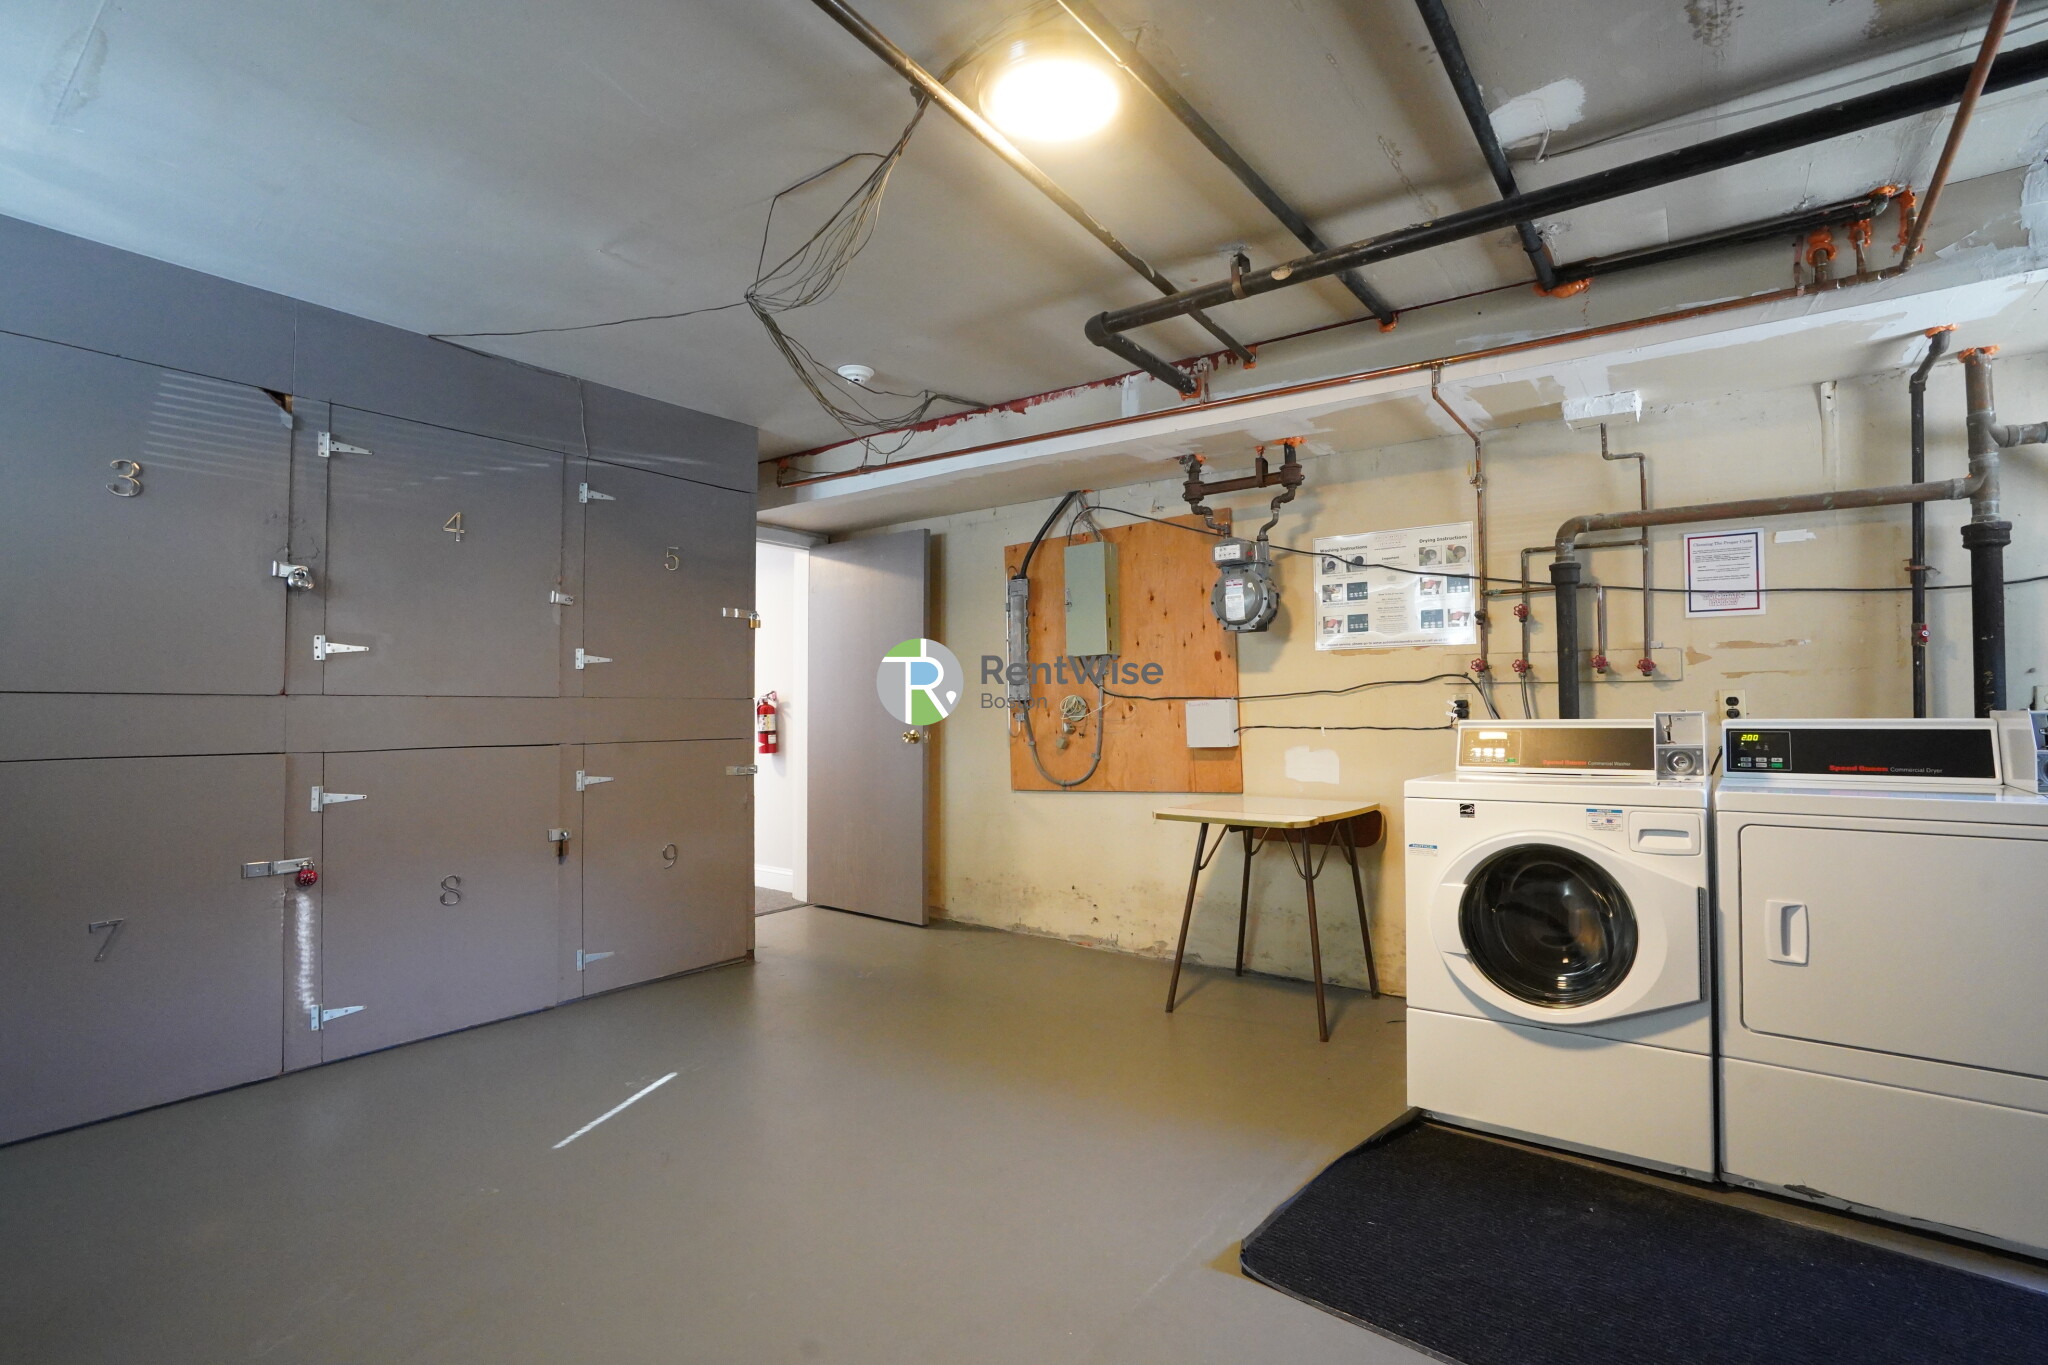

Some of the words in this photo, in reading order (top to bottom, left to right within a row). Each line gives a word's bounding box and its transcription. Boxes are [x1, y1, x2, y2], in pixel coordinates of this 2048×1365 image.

[106, 459, 144, 498] 3
[442, 510, 466, 542] 4
[1436, 534, 1468, 542] Instructions
[664, 545, 680, 572] 5
[1340, 544, 1368, 552] Instructions
[662, 842, 678, 870] 9
[440, 873, 463, 907] 8
[88, 917, 124, 962] 7
